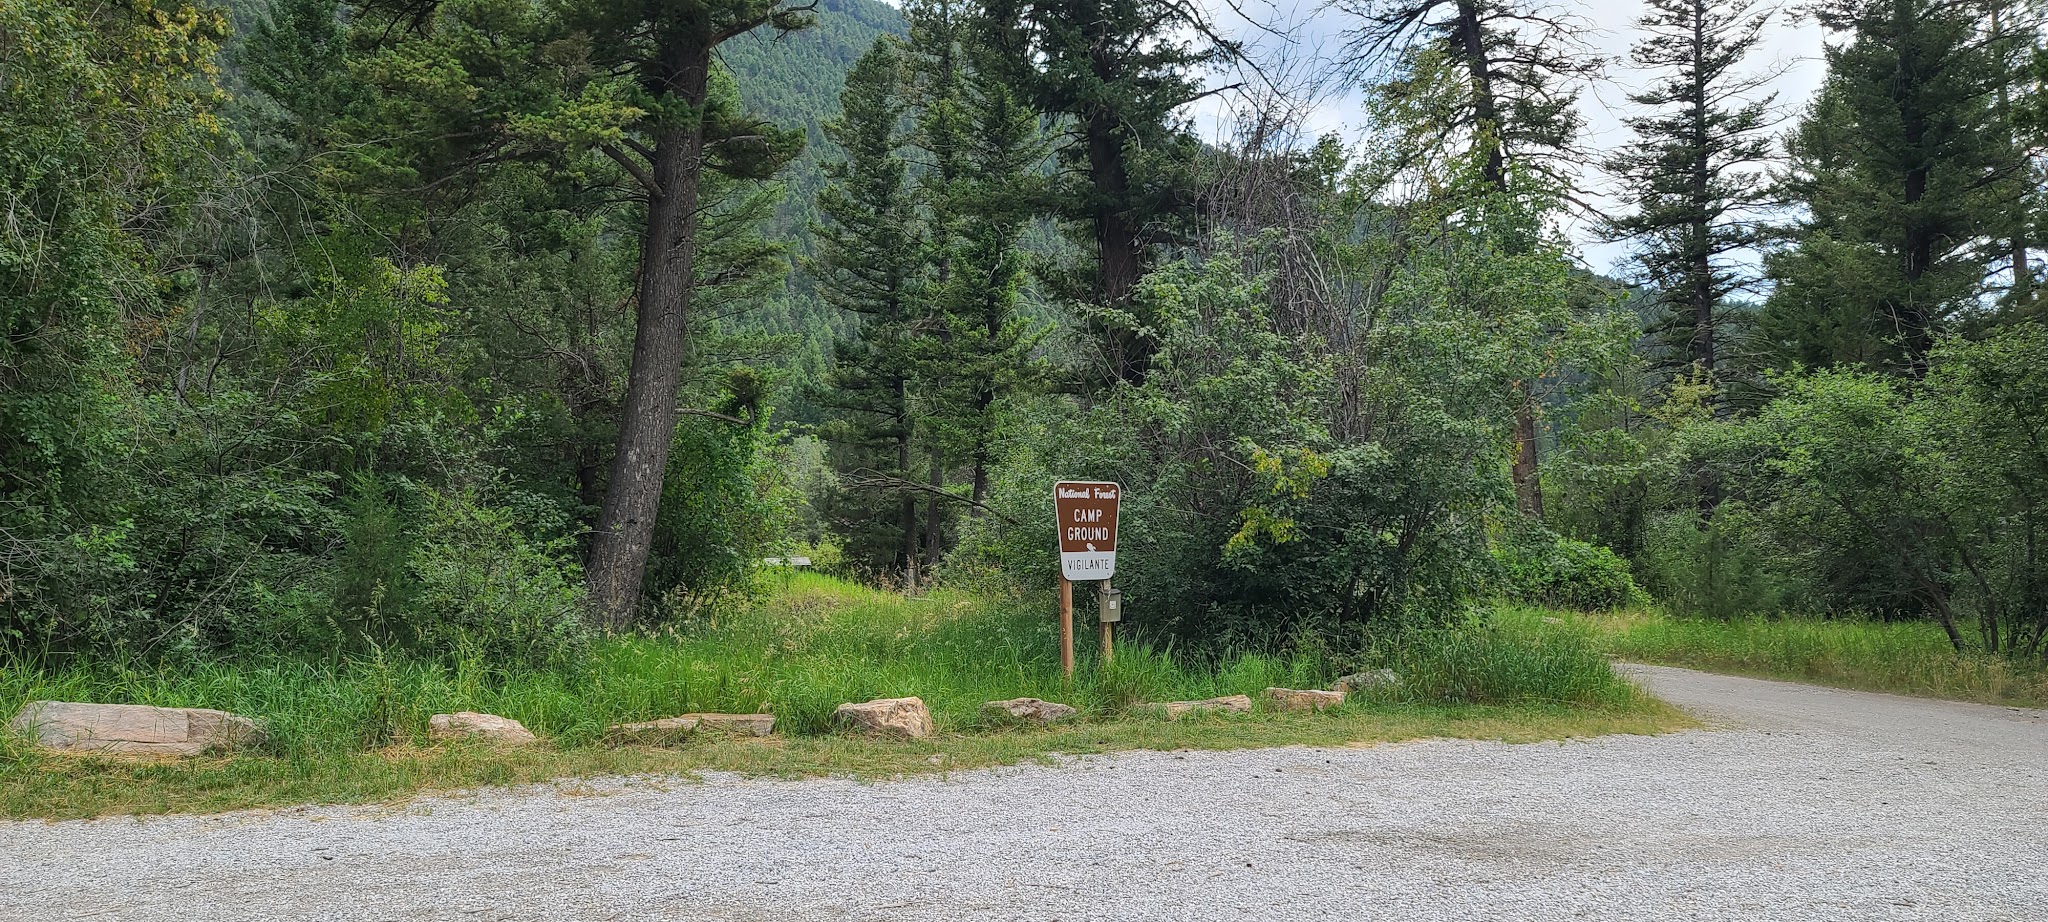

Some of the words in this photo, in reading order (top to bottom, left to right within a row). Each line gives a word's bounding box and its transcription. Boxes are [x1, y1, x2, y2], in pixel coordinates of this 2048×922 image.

[1058, 487, 1090, 499] National
[1094, 487, 1116, 499] Forest
[1074, 509, 1102, 522] CAMP
[1067, 527, 1109, 541] GROUND
[1067, 559, 1109, 570] VIGILANTE
